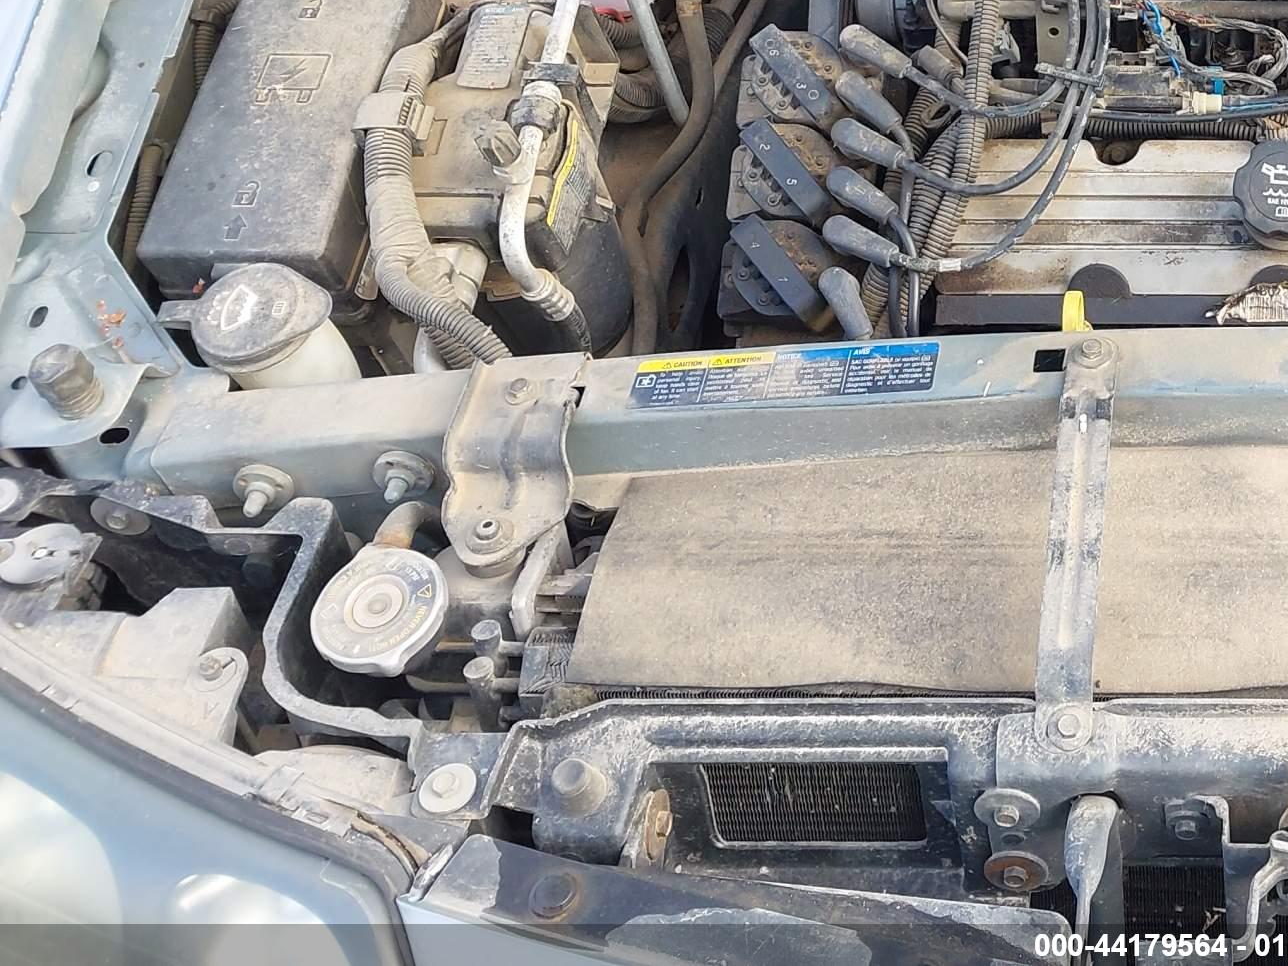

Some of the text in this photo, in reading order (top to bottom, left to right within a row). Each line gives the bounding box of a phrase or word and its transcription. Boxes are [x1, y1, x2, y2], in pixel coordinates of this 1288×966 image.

[759, 143, 771, 152] 2
[786, 177, 798, 186] 5
[673, 360, 703, 369] CAUTION
[724, 355, 763, 365] ATTENTION
